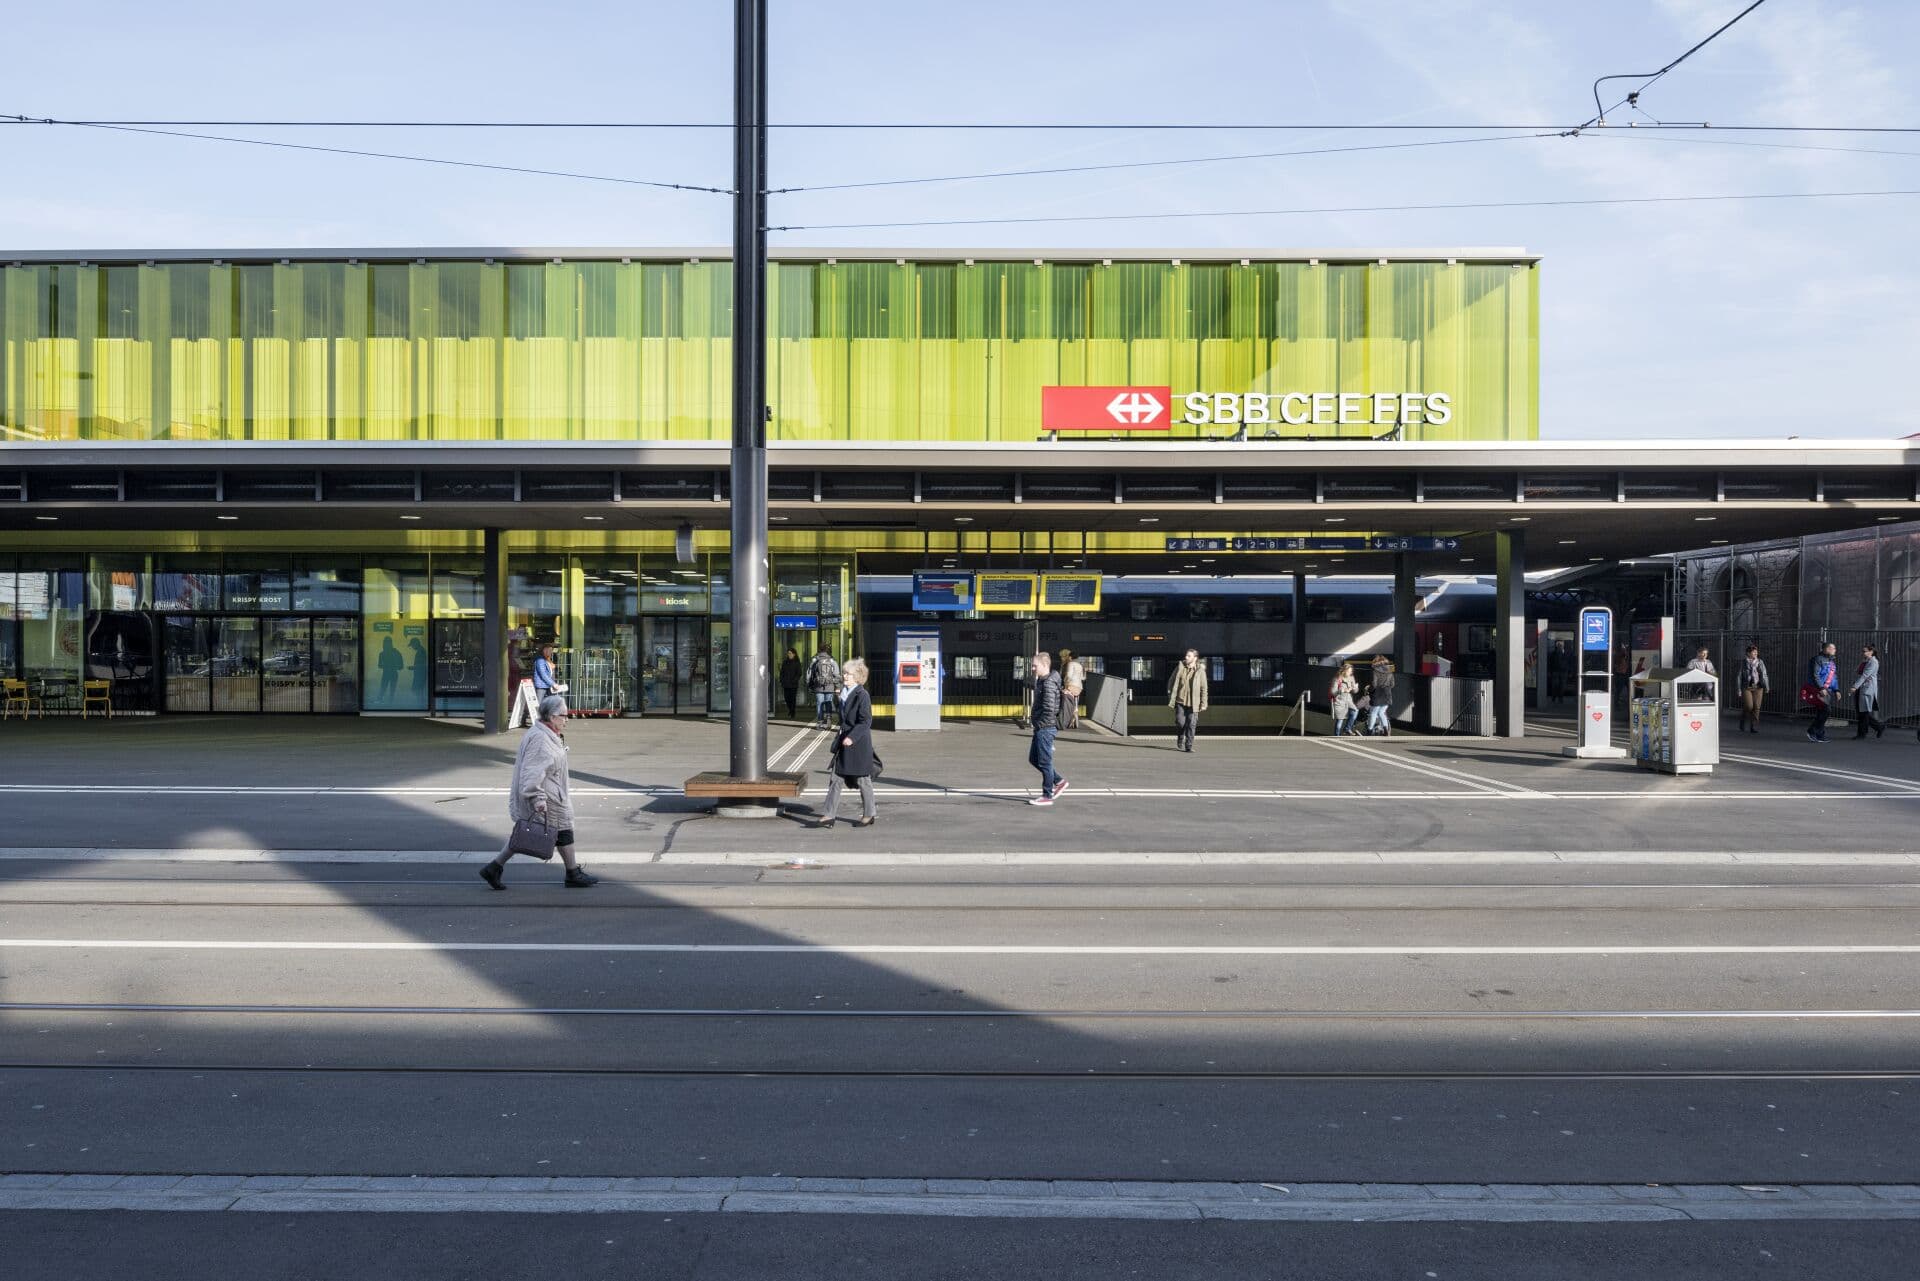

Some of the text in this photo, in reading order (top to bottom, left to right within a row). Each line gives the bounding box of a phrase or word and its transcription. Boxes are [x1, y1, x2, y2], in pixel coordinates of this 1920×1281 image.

[1184, 392, 1453, 424] SBB CFF FFS
[666, 597, 690, 606] kiosk
